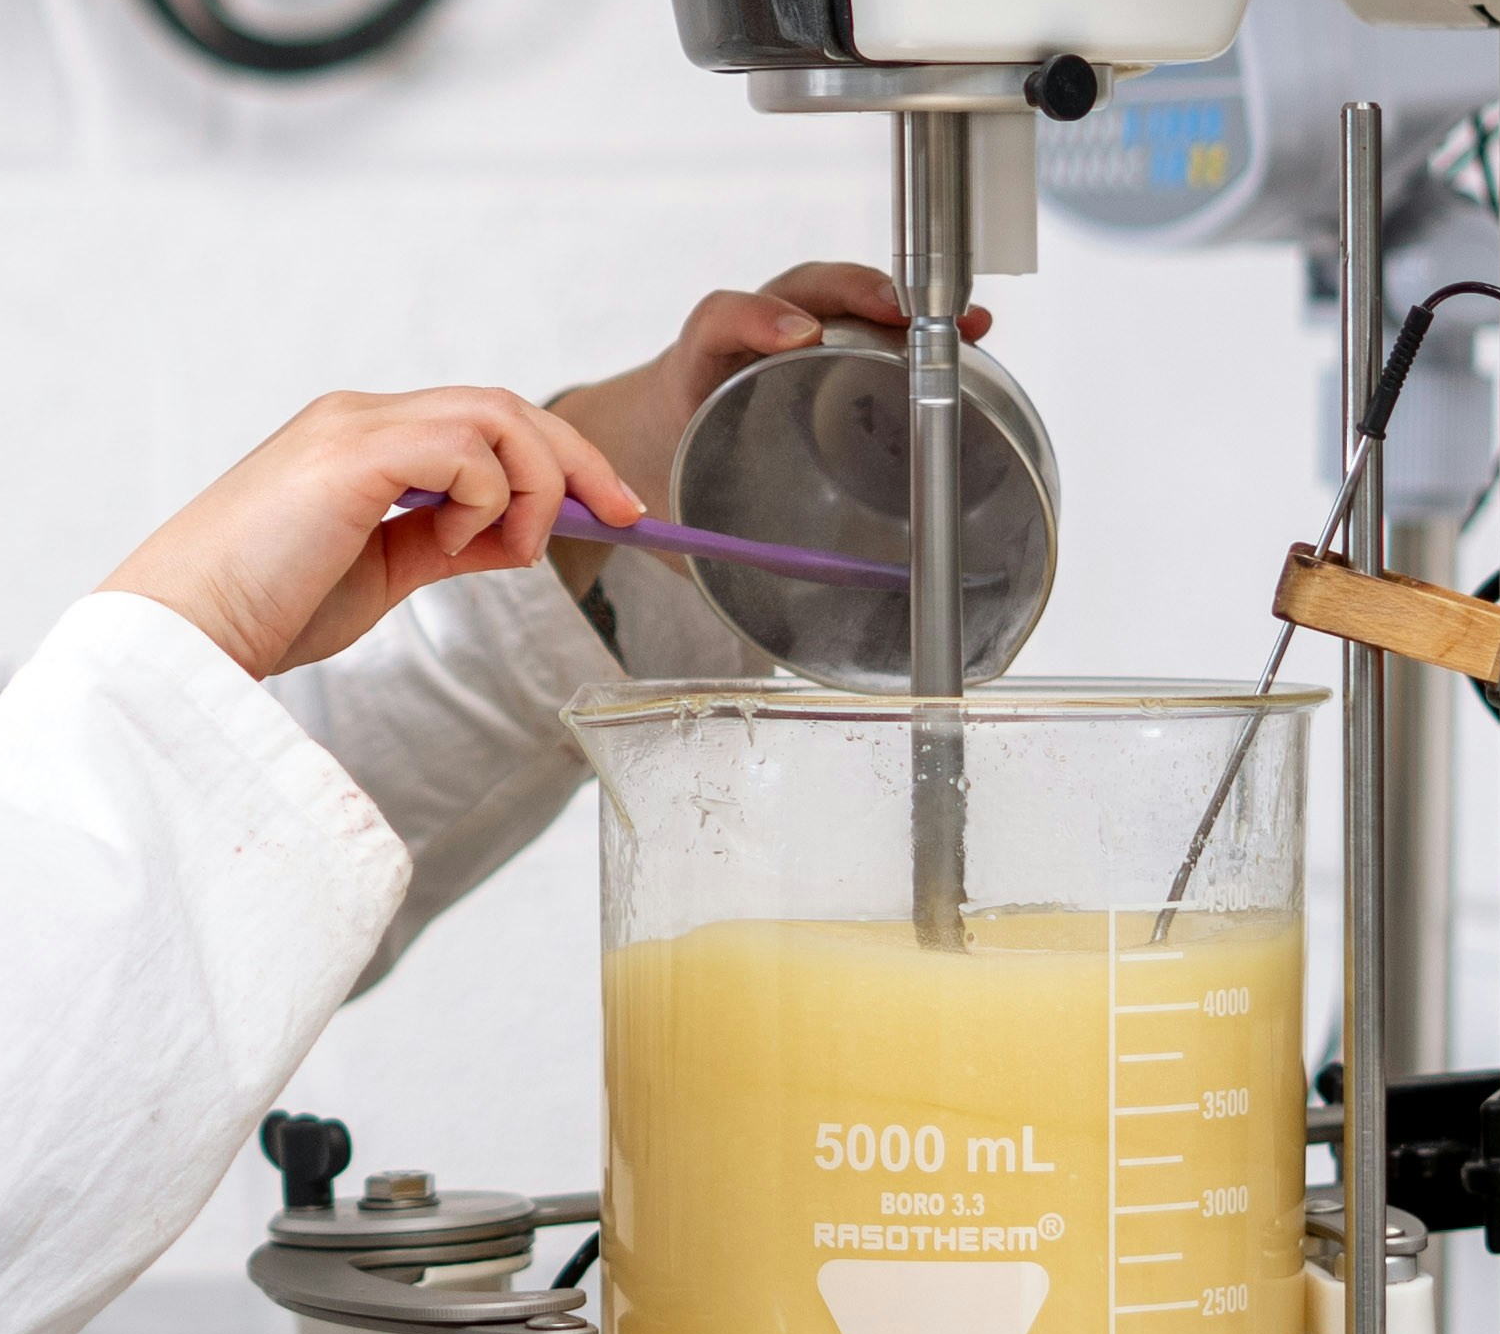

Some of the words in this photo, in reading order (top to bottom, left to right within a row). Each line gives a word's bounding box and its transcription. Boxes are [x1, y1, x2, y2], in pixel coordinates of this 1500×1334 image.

[1205, 883, 1251, 914] 4500
[1203, 987, 1250, 1018] 4000
[1202, 1088, 1249, 1120] 3500
[814, 1123, 946, 1174] 5000
[967, 1125, 1055, 1173] mL
[881, 1192, 945, 1216] BORO
[951, 1193, 985, 1216] 3.3
[1202, 1185, 1249, 1218] 3000
[1202, 1284, 1248, 1316] 2500
